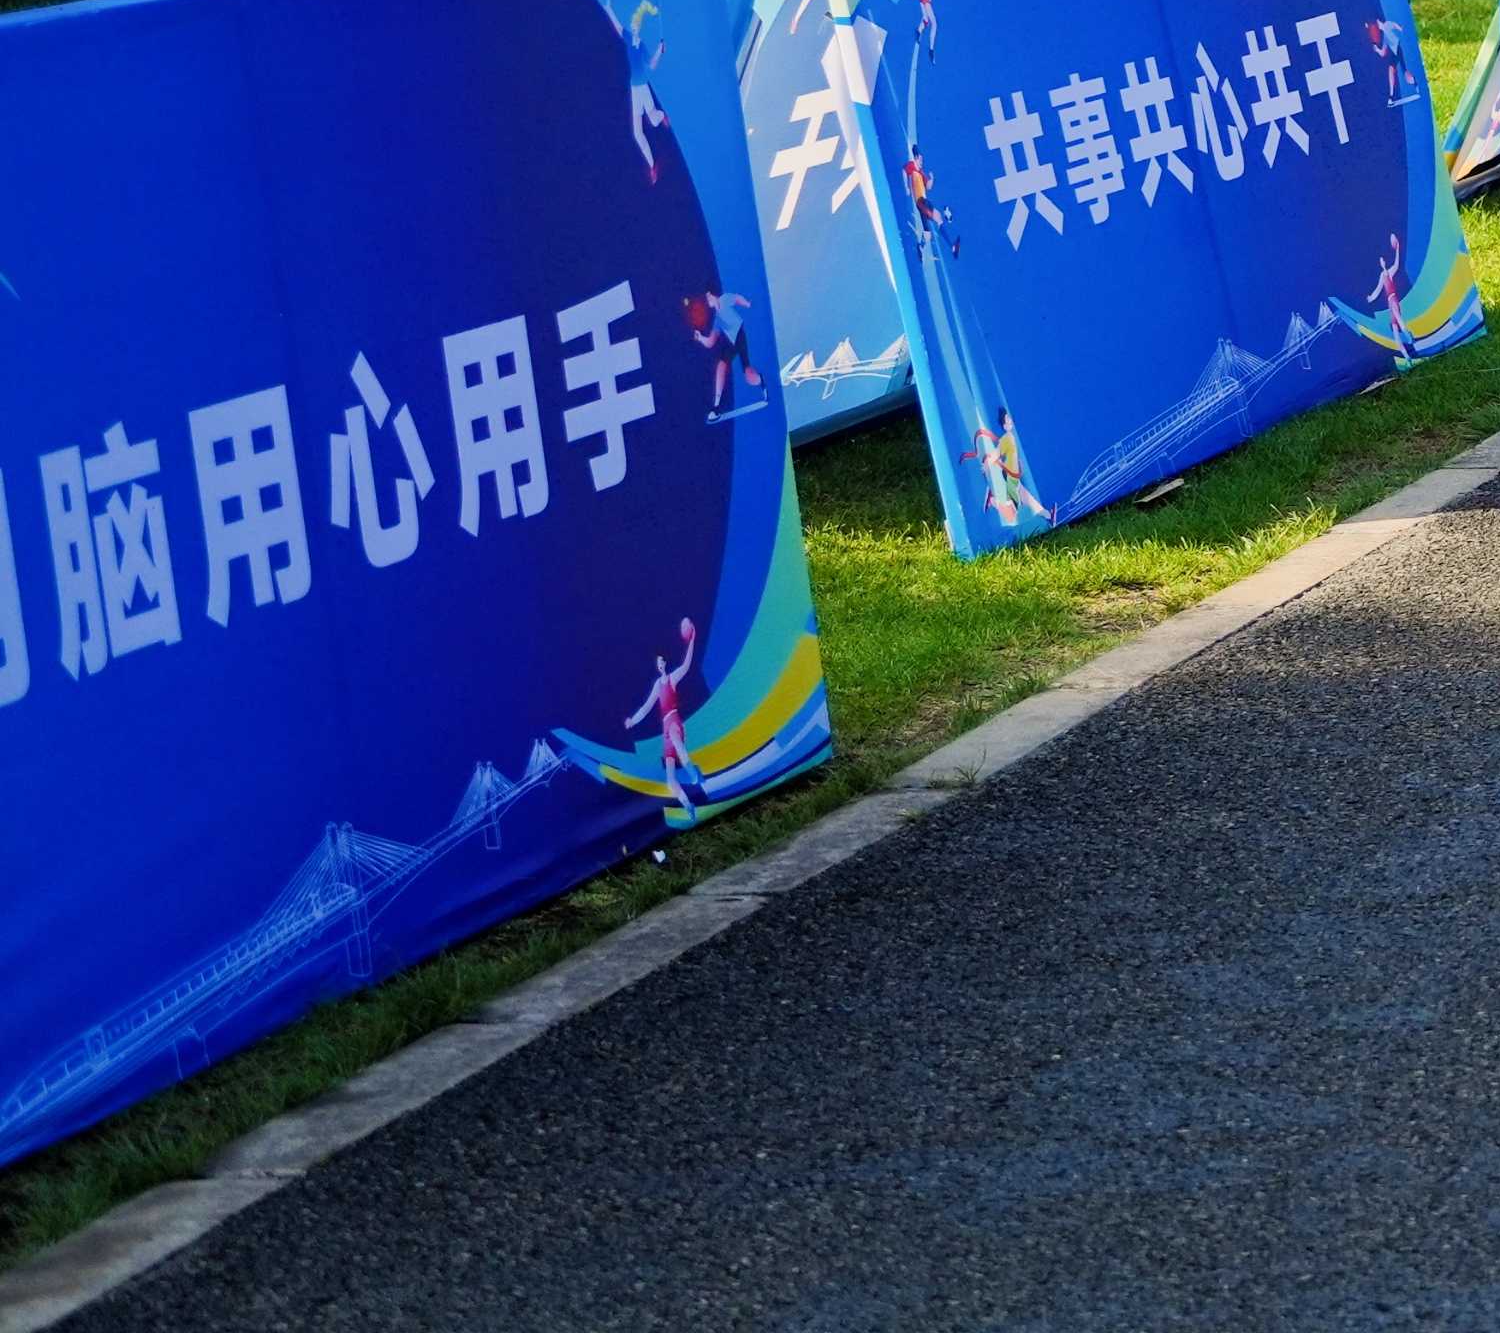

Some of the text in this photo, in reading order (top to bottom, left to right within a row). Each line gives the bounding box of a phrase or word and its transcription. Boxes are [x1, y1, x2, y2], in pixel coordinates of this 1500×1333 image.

[983, 11, 1355, 251] 共事共心共干
[0, 281, 656, 709] 脑用心用手
